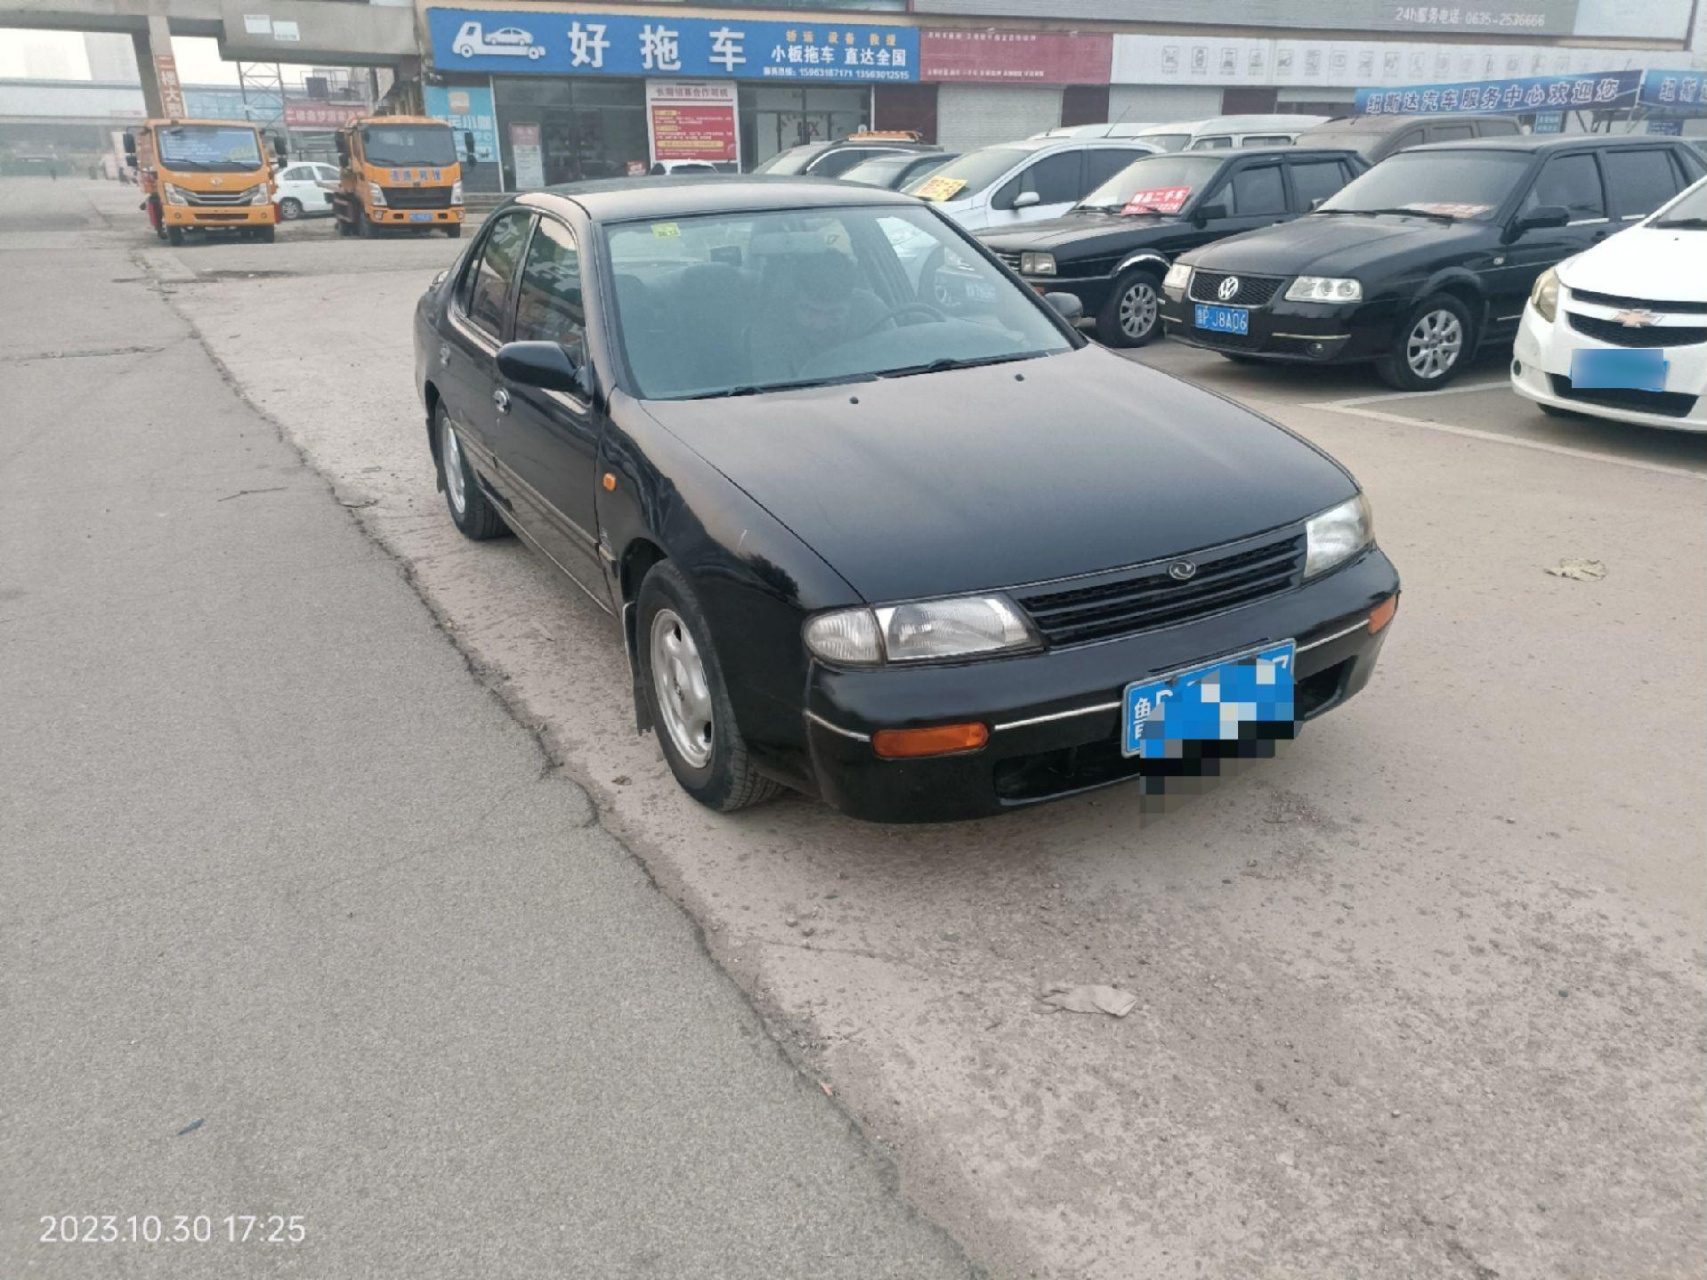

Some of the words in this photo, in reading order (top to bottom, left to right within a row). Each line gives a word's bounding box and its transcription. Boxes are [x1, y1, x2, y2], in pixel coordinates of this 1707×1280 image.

[567, 21, 748, 73] 好拖车
[771, 45, 835, 63] 小板拖车
[844, 48, 906, 67] 直达全国
